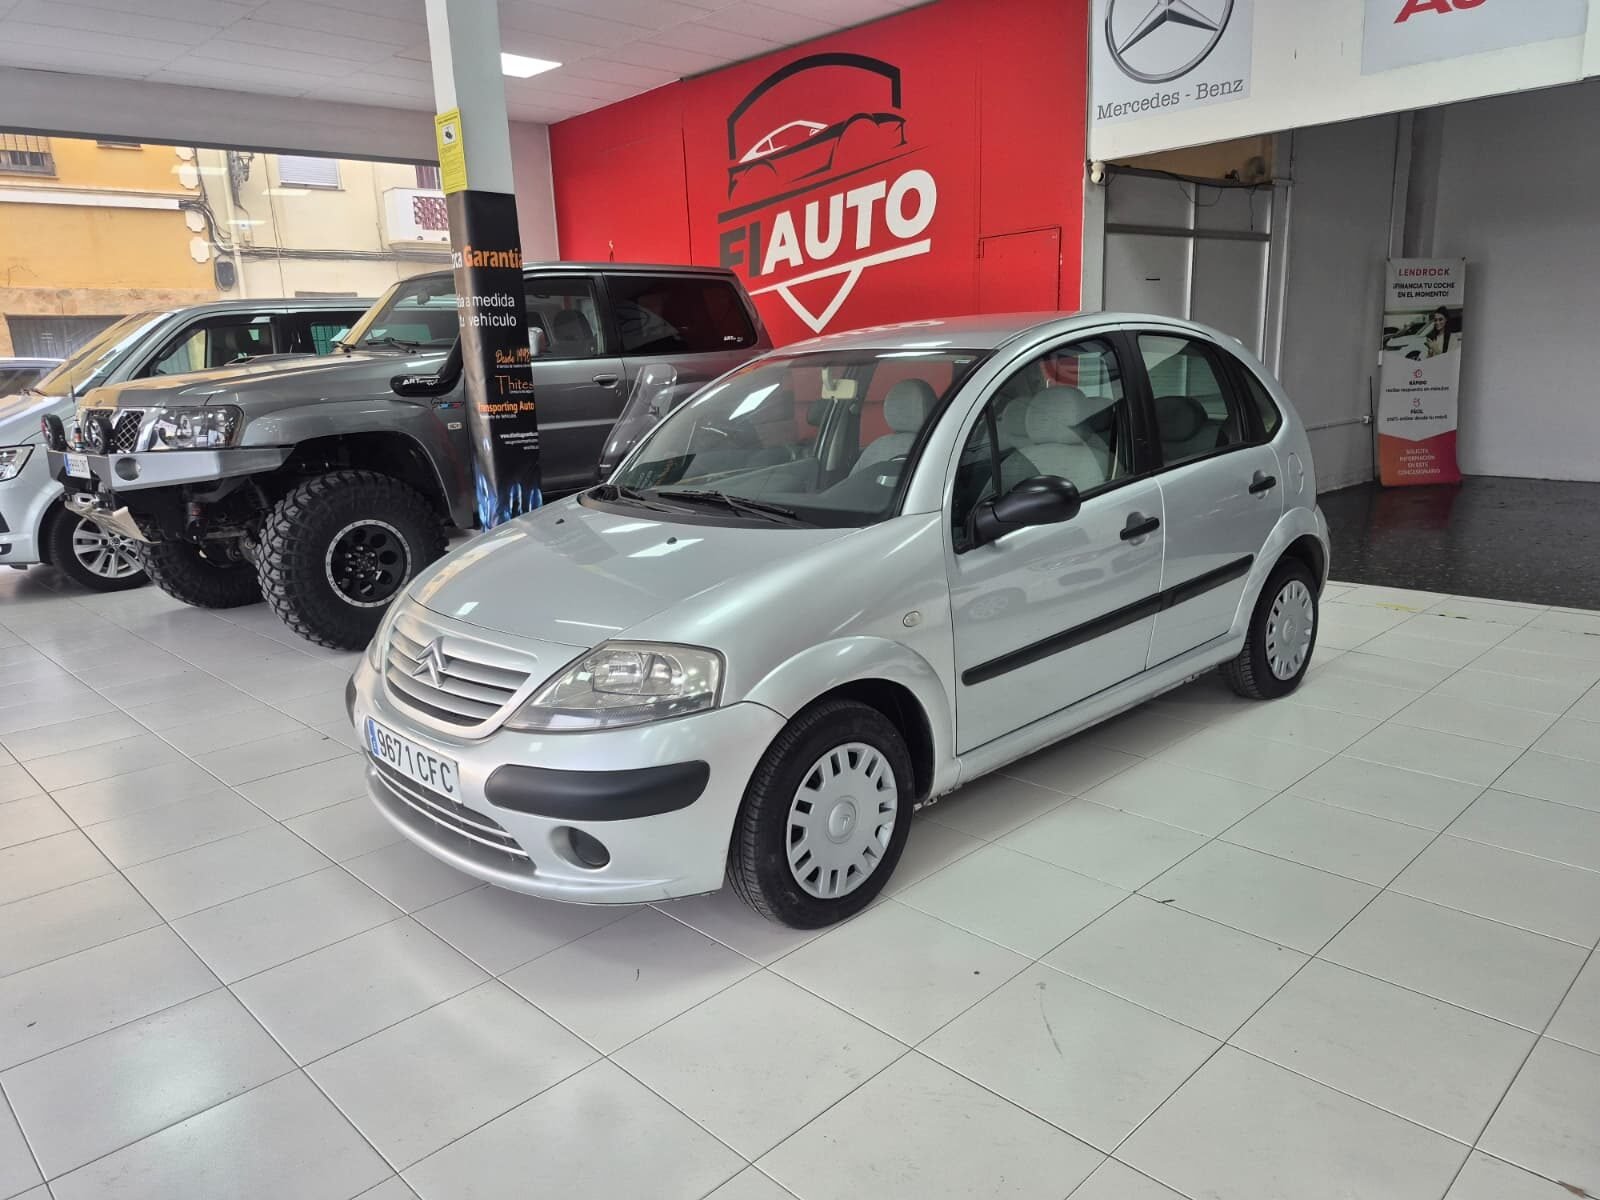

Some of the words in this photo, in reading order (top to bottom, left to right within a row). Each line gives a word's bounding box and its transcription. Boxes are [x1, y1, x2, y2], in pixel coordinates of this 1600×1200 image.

[1096, 91, 1181, 121] Mercedes
[1195, 78, 1244, 101] Benz
[1398, 268, 1450, 276] LENDROCK
[472, 292, 515, 307] medida
[1415, 290, 1449, 298] MOMENTO!
[377, 728, 415, 776] 9671
[416, 751, 454, 794] CFC
